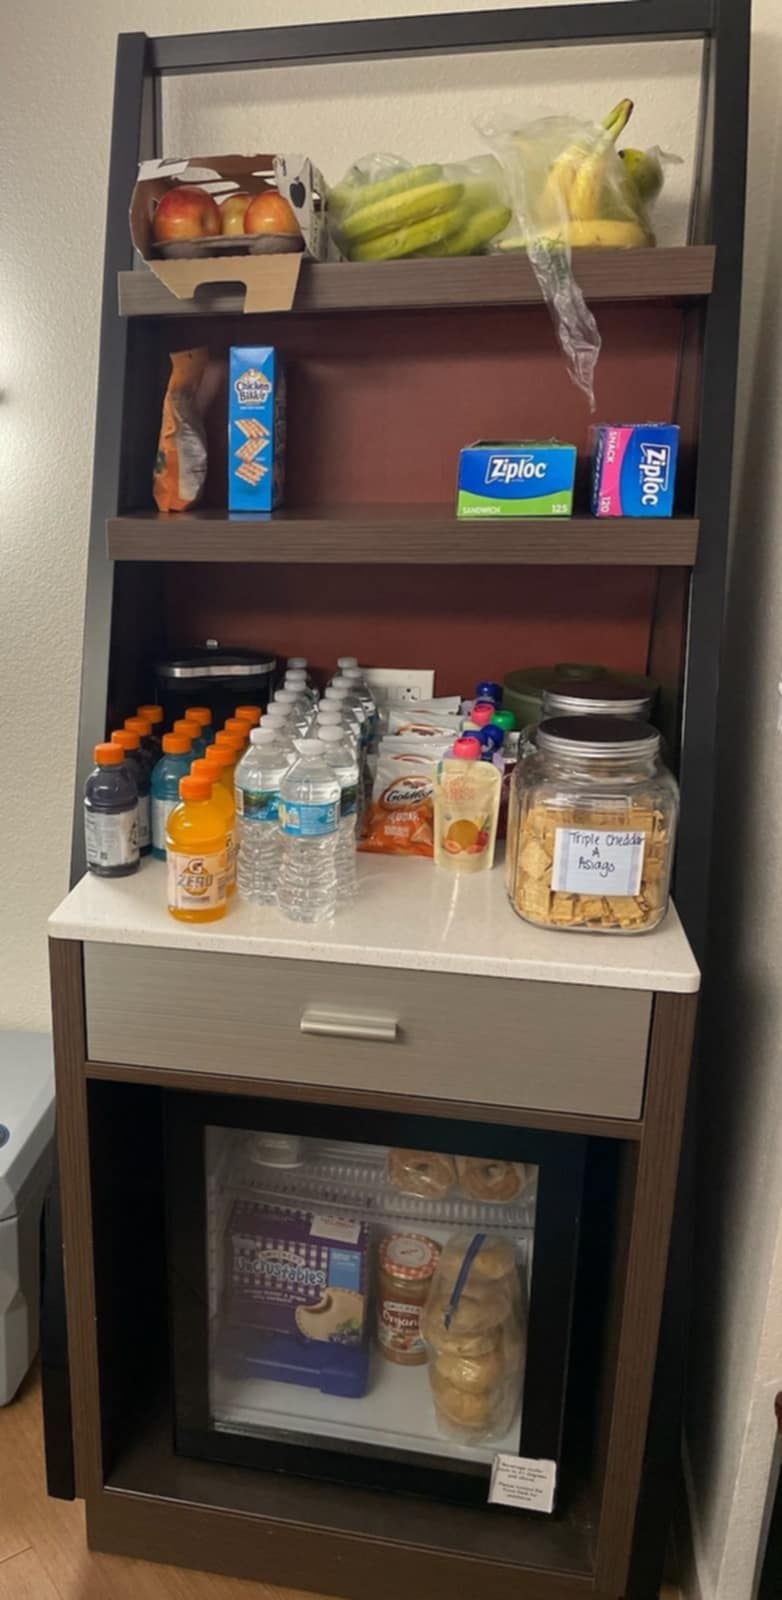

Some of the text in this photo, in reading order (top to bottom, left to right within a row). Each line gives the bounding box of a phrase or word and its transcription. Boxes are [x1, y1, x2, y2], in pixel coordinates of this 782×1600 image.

[607, 431, 618, 464] SNACK
[491, 458, 547, 484] Ziploc
[638, 448, 667, 507] Ziploc
[551, 503, 568, 513] 125
[600, 496, 611, 512] 120
[569, 831, 601, 847] Triple
[578, 856, 615, 878] Asiago
[177, 874, 213, 888] ZERO
[238, 1257, 326, 1285] Uncrustables
